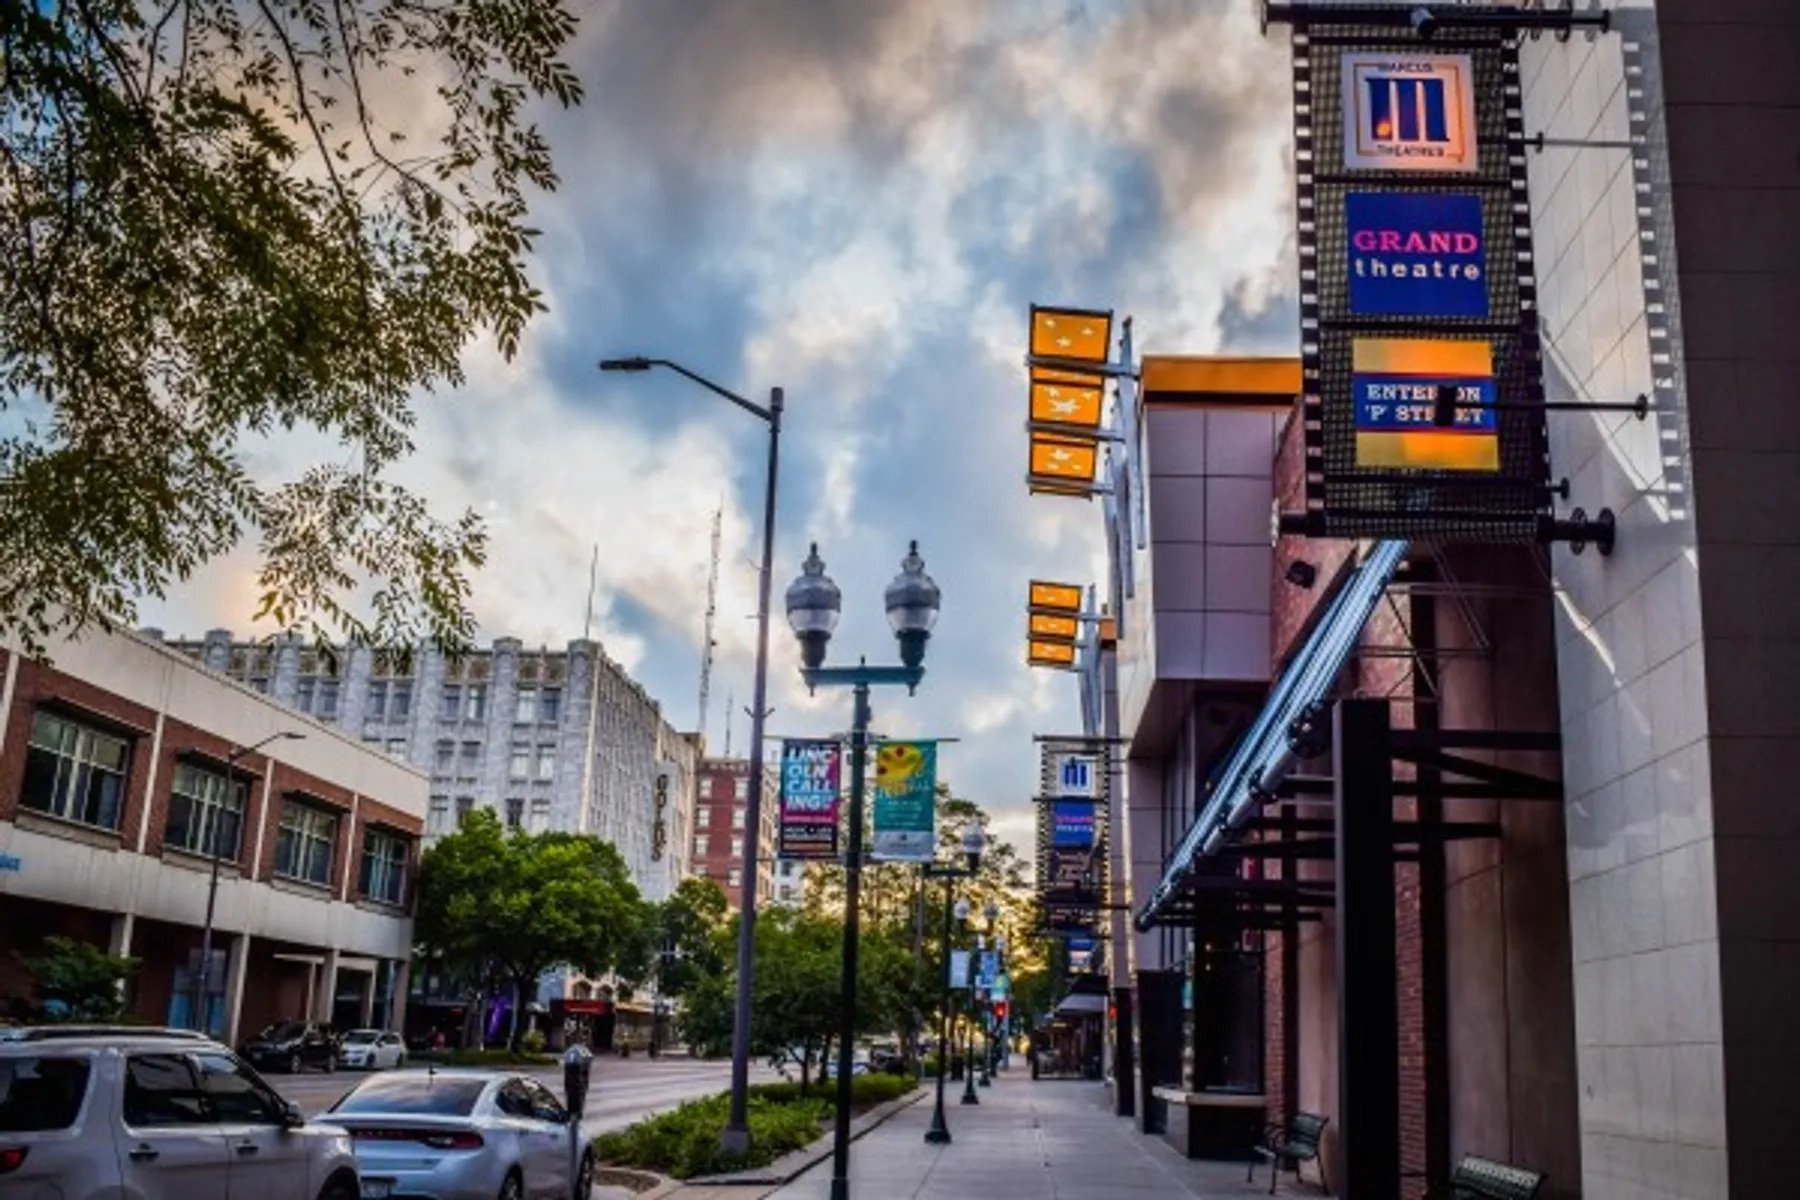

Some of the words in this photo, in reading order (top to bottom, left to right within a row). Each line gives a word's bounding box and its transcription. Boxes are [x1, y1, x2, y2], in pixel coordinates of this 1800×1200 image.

[1353, 230, 1479, 254] GRAND
[1355, 258, 1481, 281] theatre
[1395, 404, 1485, 425] STRET
[787, 779, 833, 794] CALL
